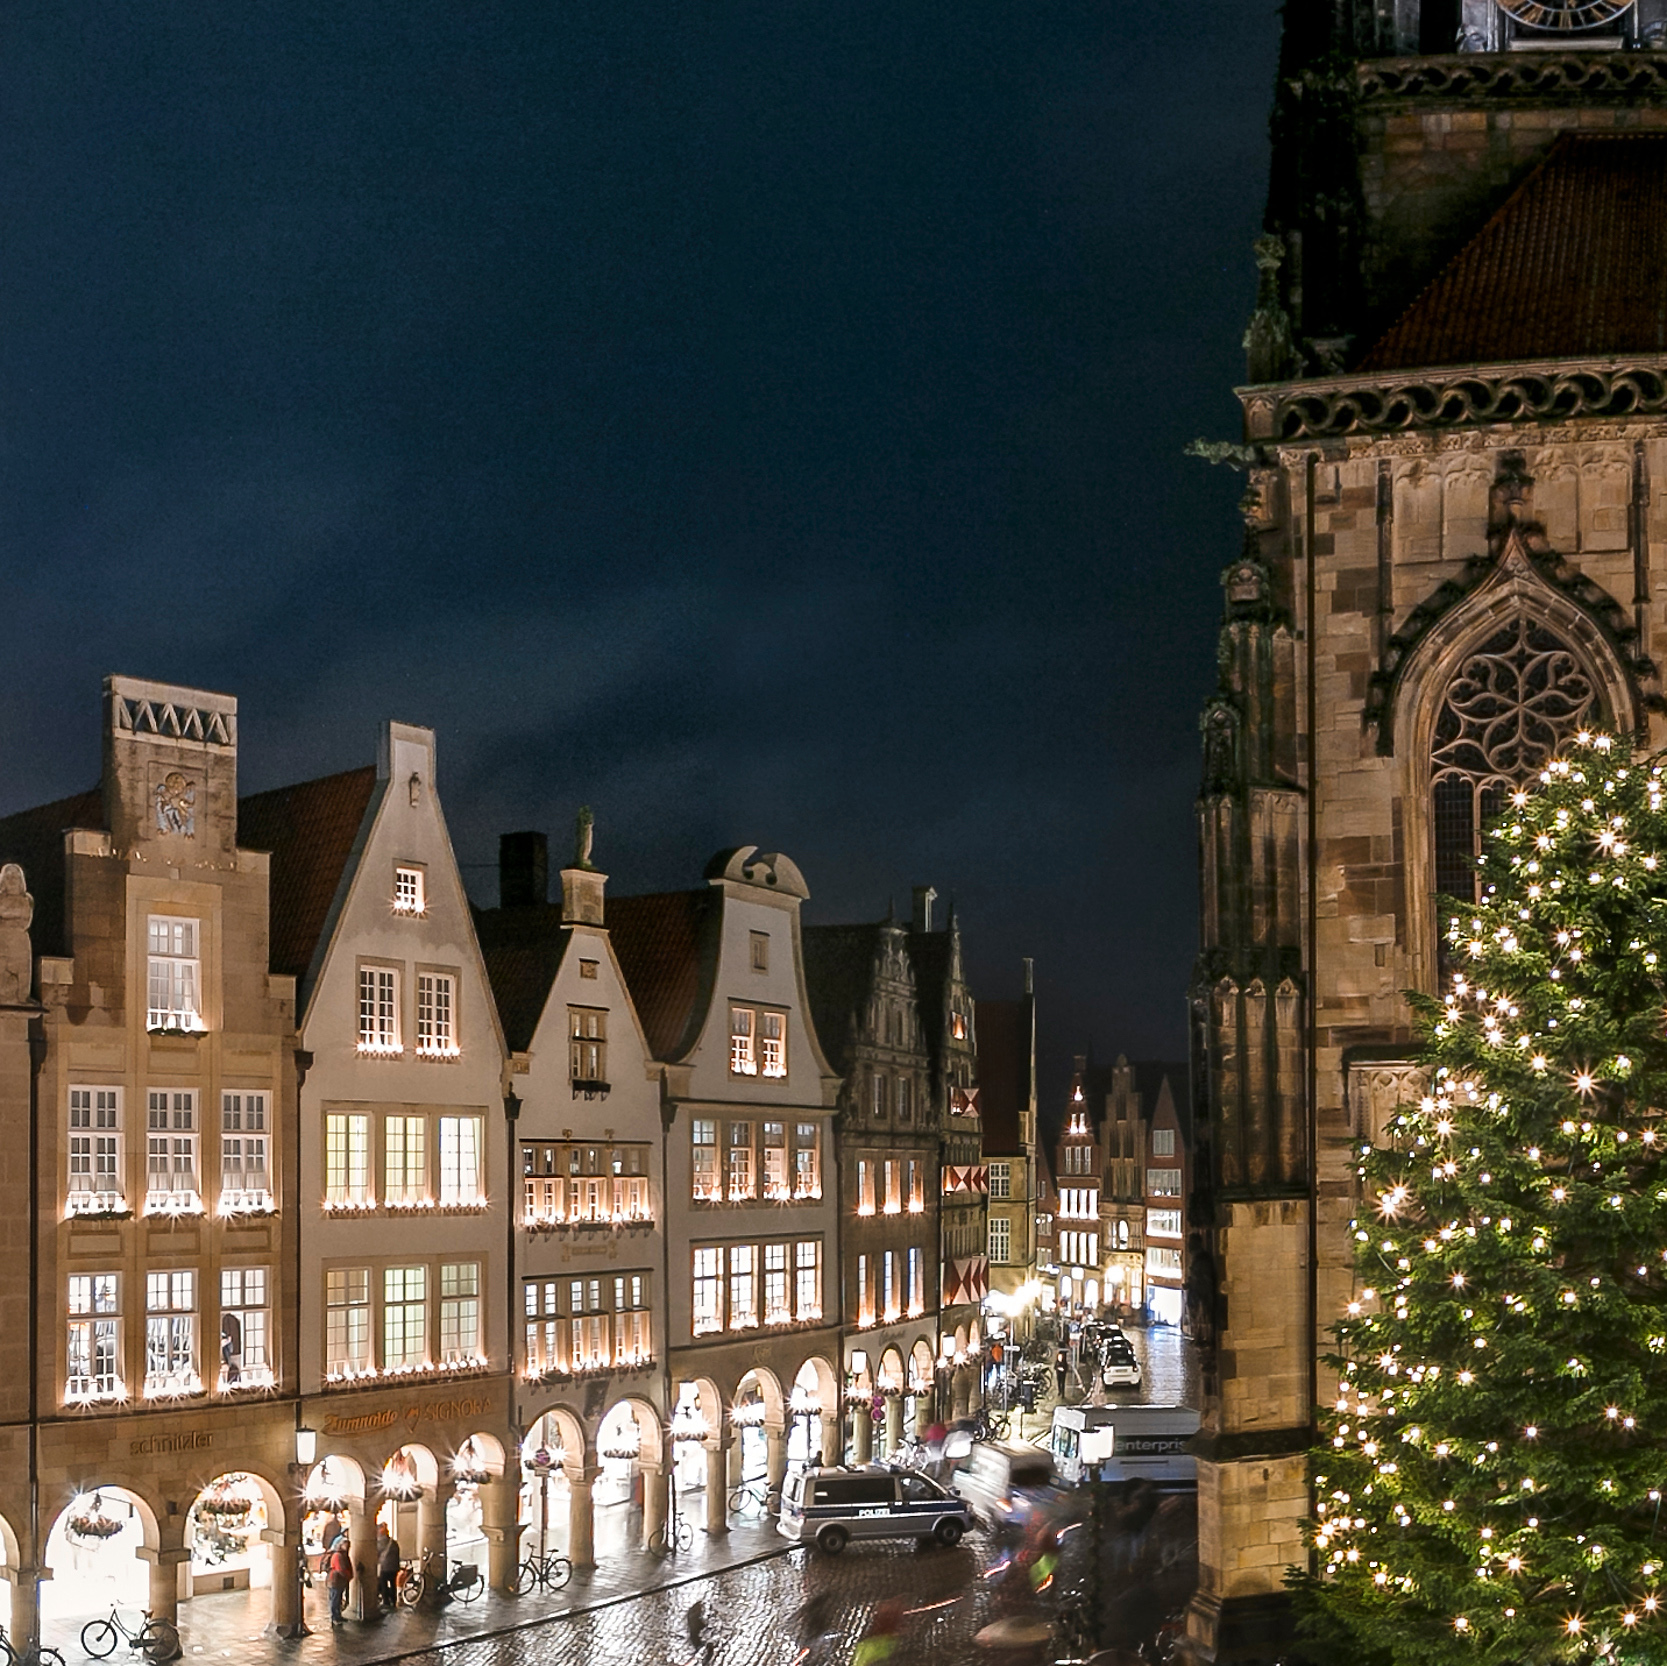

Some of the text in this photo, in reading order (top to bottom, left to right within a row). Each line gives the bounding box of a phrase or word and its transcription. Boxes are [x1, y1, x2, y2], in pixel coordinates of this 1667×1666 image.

[424, 1398, 491, 1421] SIGNORA
[129, 1430, 213, 1456] schnitzler
[1114, 1438, 1188, 1452] enterpris
